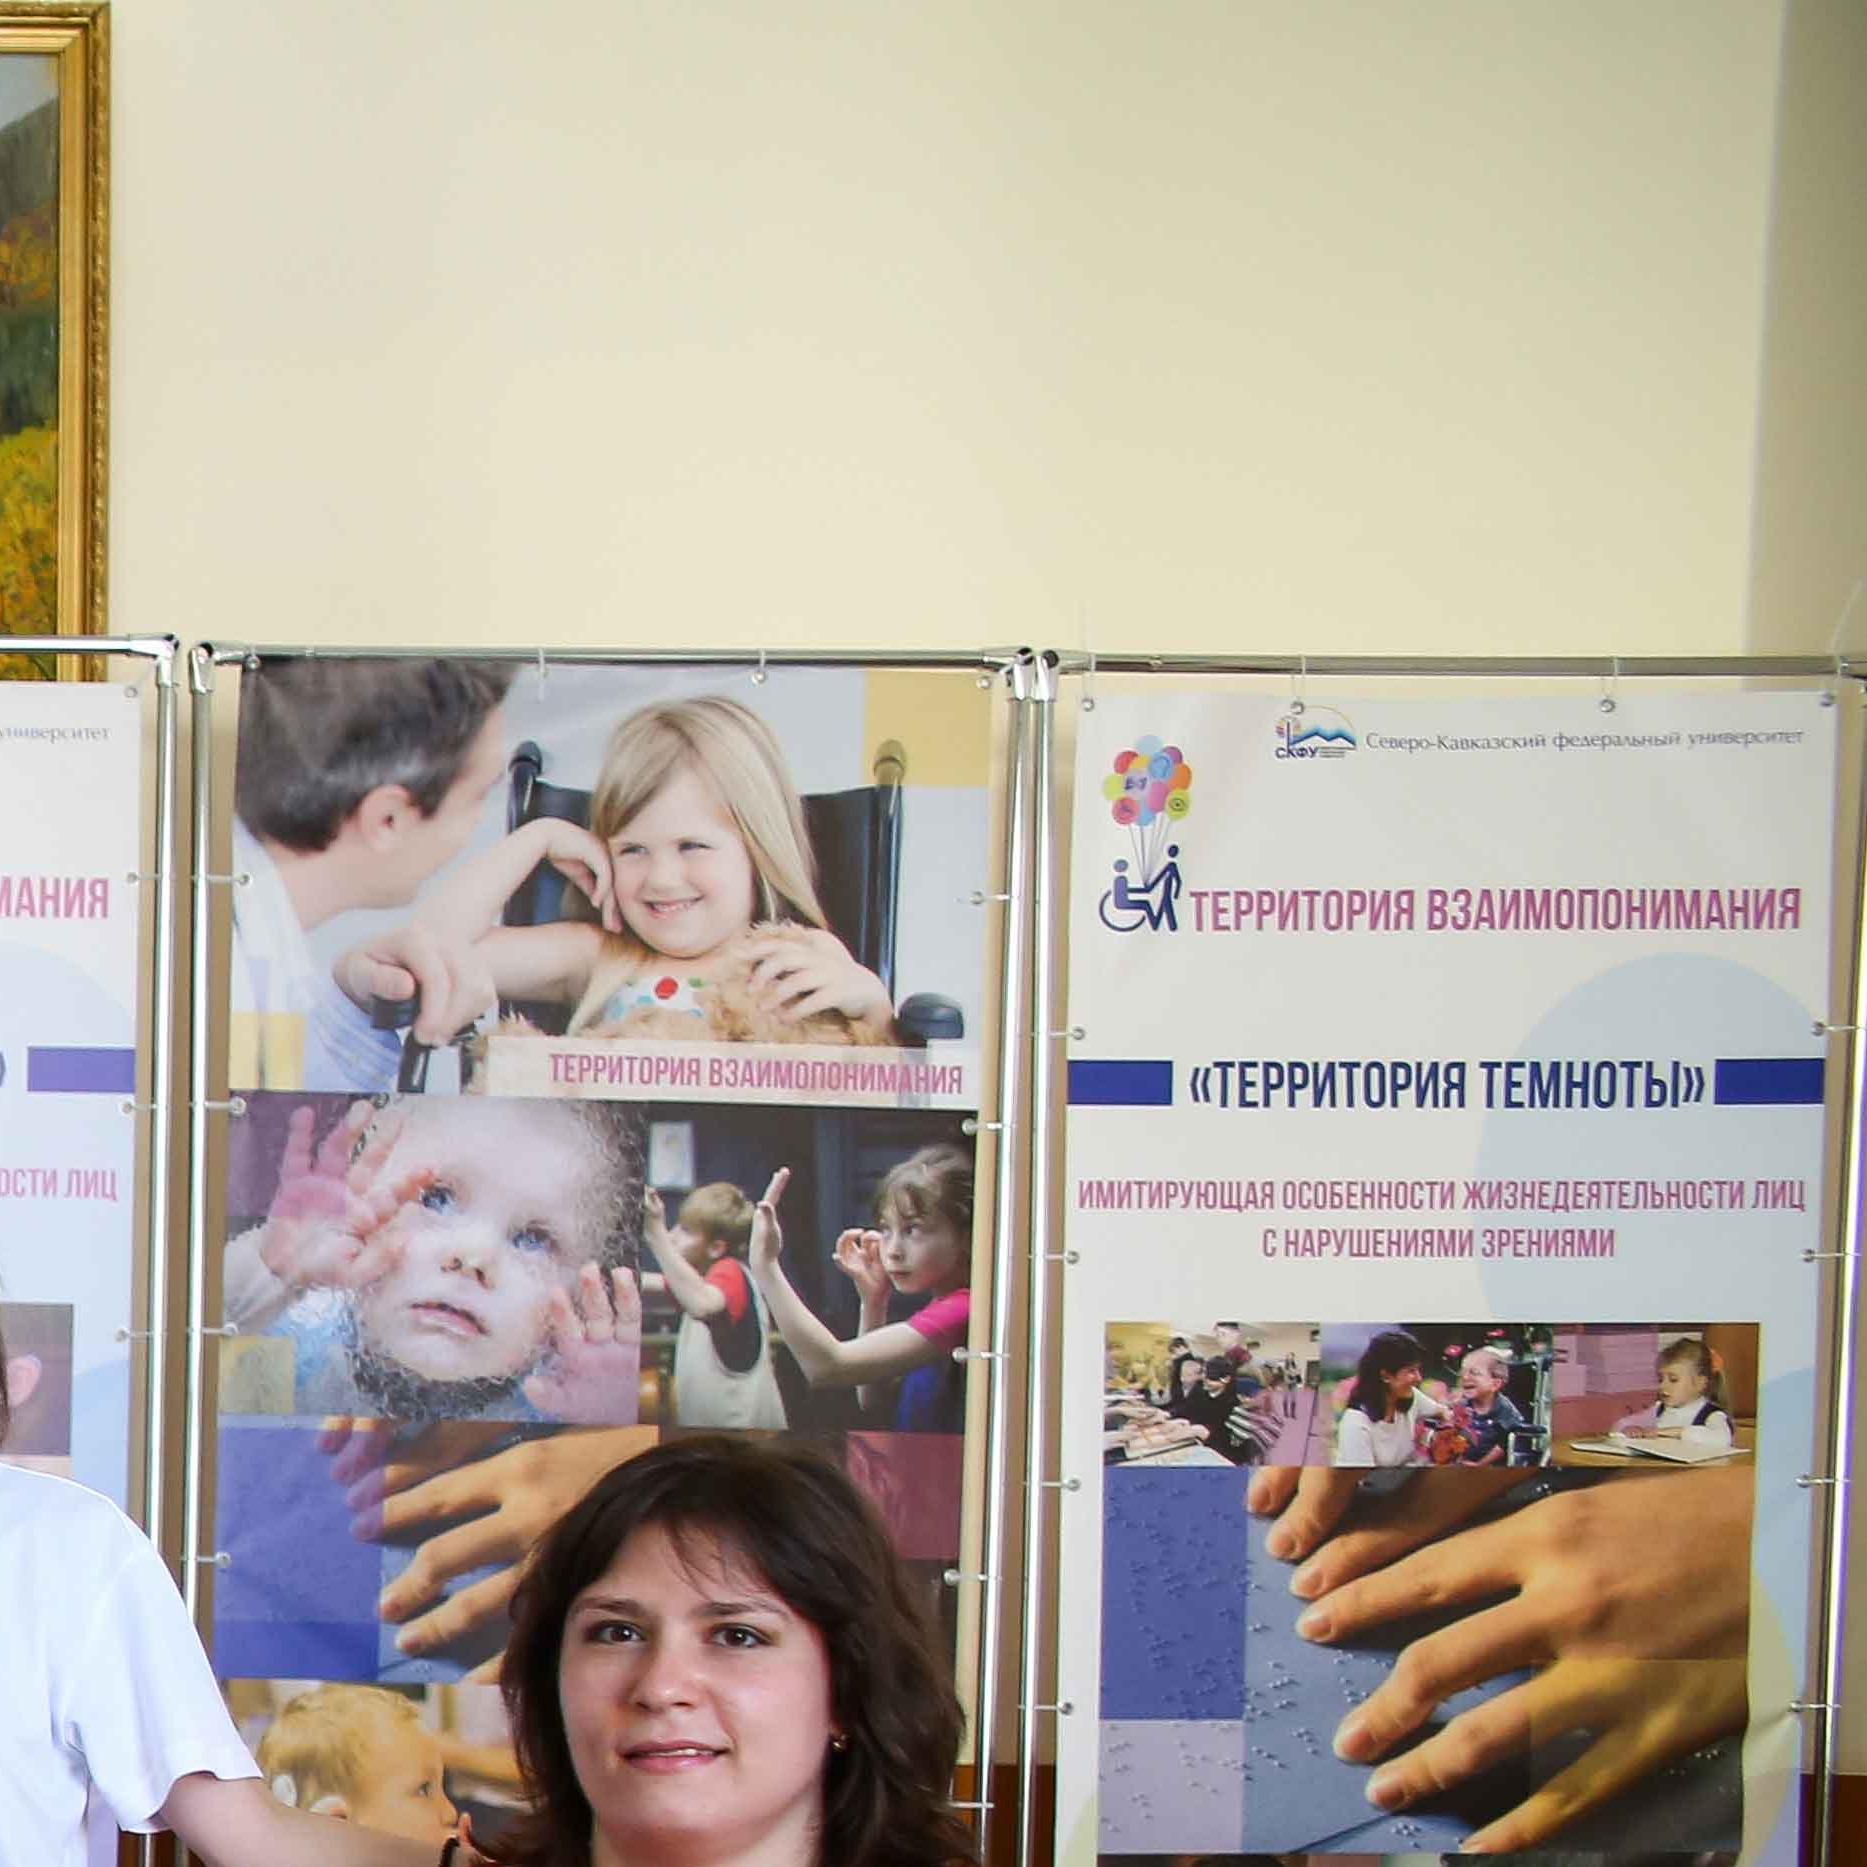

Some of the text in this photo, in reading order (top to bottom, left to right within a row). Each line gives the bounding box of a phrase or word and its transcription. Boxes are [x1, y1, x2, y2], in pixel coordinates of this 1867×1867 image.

[1275, 745, 1318, 759] СКФУ
[1366, 731, 1547, 753] Северо-Кавказский
[1553, 731, 1680, 753] федеральный
[1688, 729, 1803, 749] университет
[1190, 888, 1802, 932] ТЕРРИТОРИЯ ВЗАИМОПОНИМАНИЯ
[549, 1053, 964, 1095] ТЕРРИТОРИЯ ВЗАИМОПОНИМАНИЯ
[1189, 1060, 1707, 1109] «ТЕРРИТОРИЯ ТЕМНОТЫ»
[64, 1168, 118, 1203] ЛИЦ
[1077, 1180, 1806, 1215] ИМИТИРУЮЩАЯ ОСОБЕННОСТИ ЖИЗНЕДЕЯТЕЛЬНОСТИ ЛИЦ
[1262, 1229, 1616, 1259] С НАРУШЕНИЯМИ ЗРЕНИЯМИ
